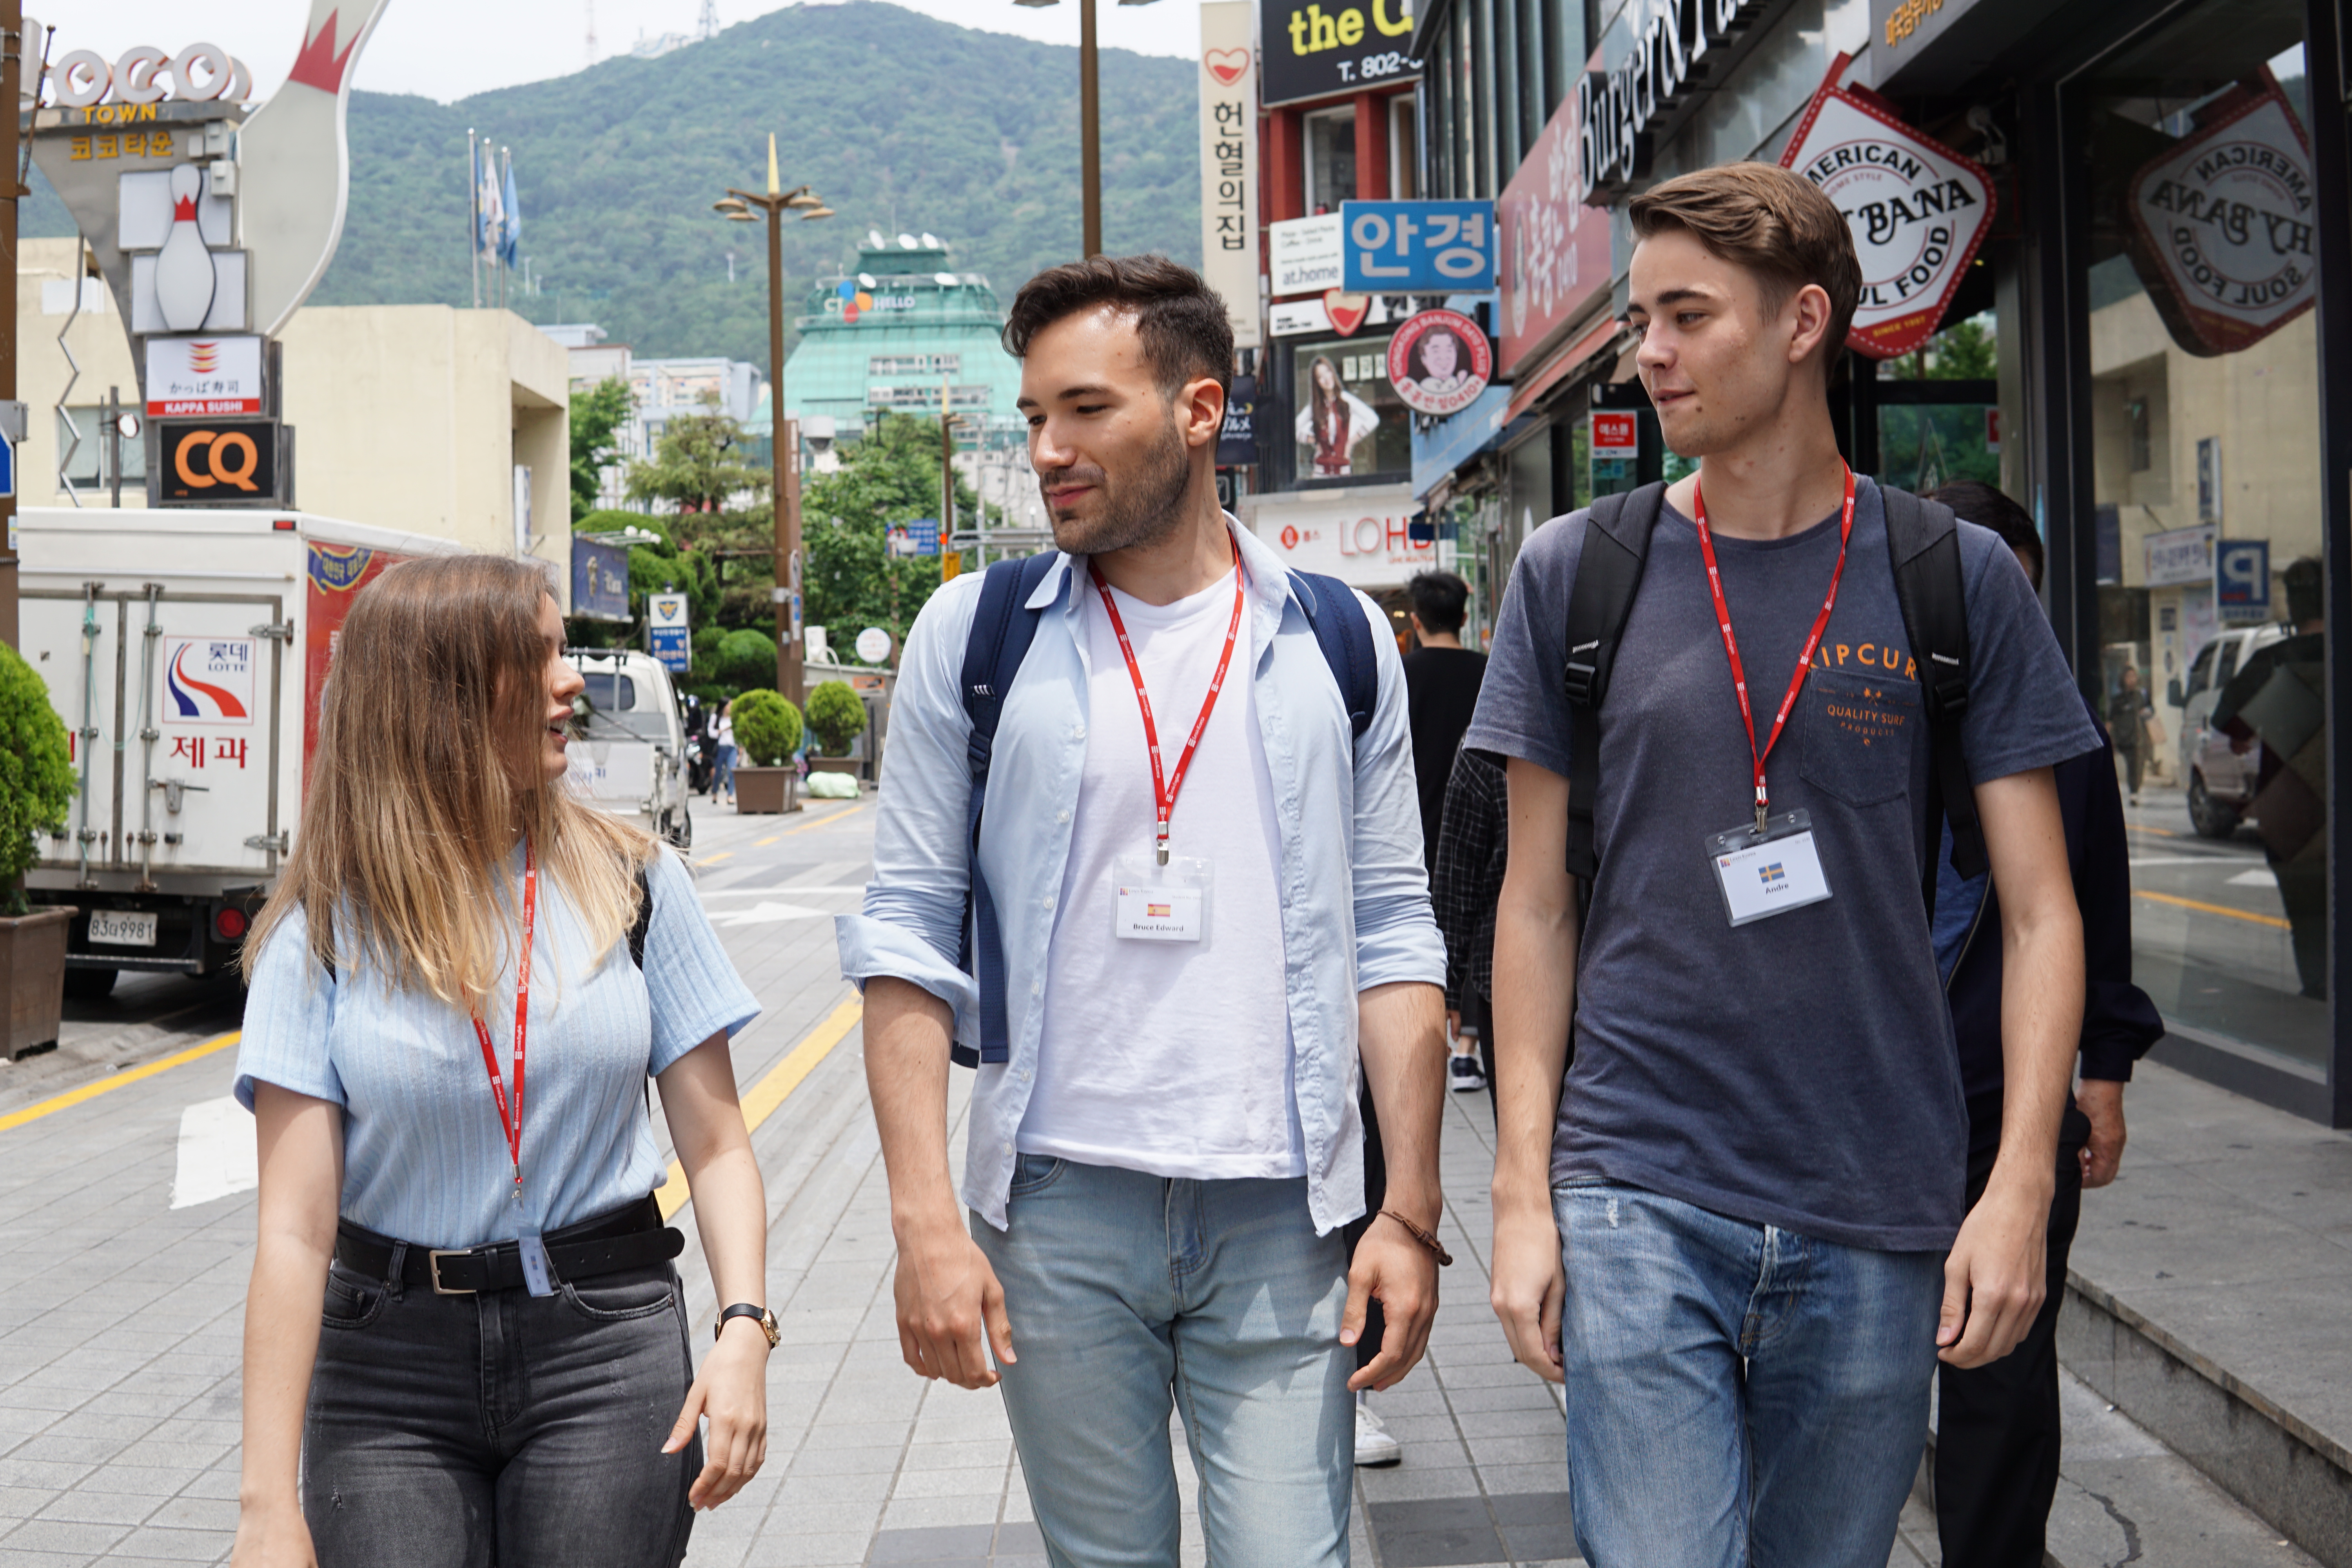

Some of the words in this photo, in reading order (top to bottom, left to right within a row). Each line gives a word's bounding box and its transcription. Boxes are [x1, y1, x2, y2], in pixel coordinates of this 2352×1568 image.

[1288, 4, 1365, 56] the
[20, 42, 231, 113] OCO
[82, 104, 157, 124] TOWN
[1576, 16, 1659, 201] Burger
[70, 131, 173, 160] 코코타운
[1213, 102, 1245, 250] 헌혈의집
[1807, 144, 1922, 186] MERICAN
[1351, 212, 1485, 278] 안경
[1896, 227, 1949, 297] FOOD
[873, 296, 915, 310] HELLO
[165, 401, 205, 414] KAPPA
[207, 400, 243, 413] SUSHI
[175, 430, 259, 491] CQ
[208, 662, 247, 672] LOTTE
[209, 642, 248, 661] 롯데
[1827, 704, 1877, 722] QUALITY
[1882, 713, 1905, 726] SURF
[1840, 721, 1894, 736] PRODUCTS
[170, 736, 248, 769] 제과
[1766, 882, 1789, 895] Andre
